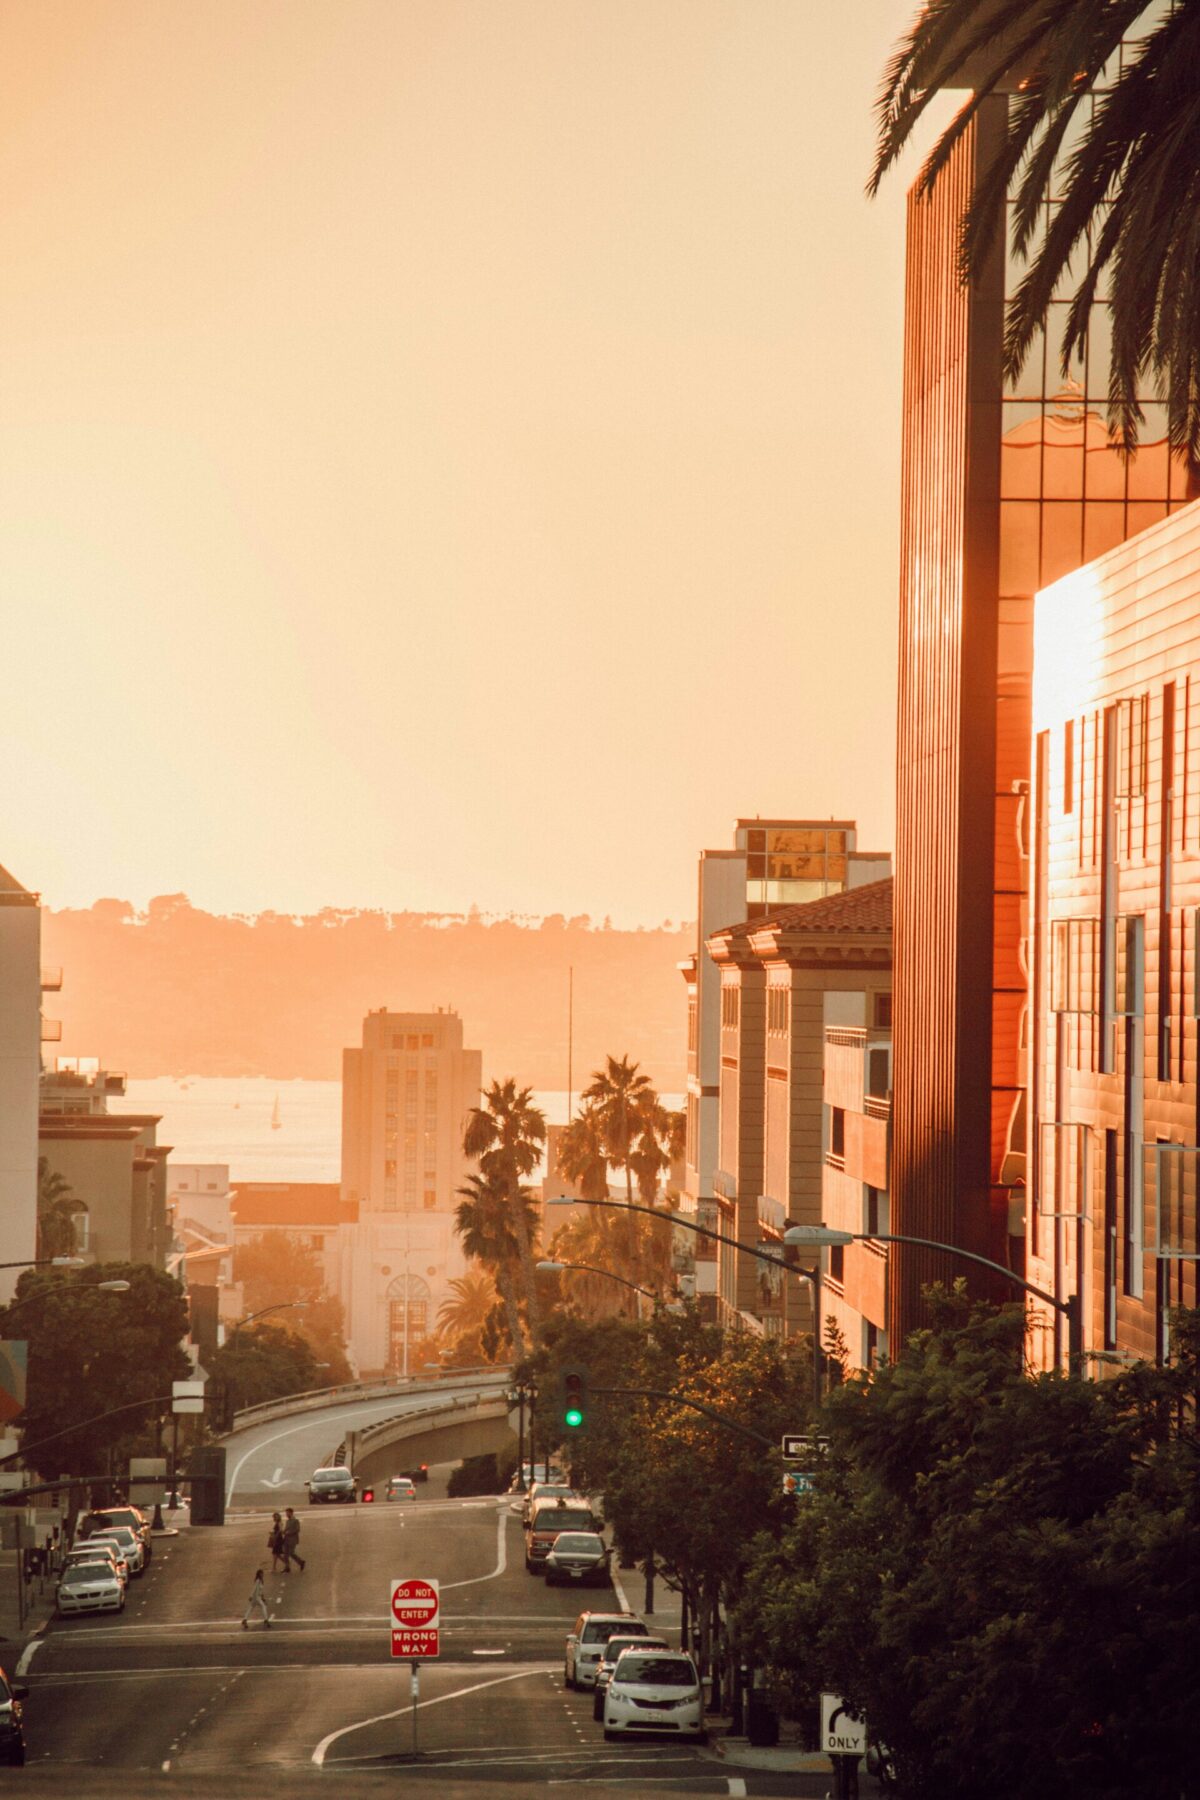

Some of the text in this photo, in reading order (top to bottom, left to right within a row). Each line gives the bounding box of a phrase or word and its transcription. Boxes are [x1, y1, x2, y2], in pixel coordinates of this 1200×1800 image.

[398, 1588, 432, 1597] DO NOT
[401, 1610, 429, 1619] ENTER
[393, 1632, 437, 1641] WRONG
[402, 1645, 428, 1653] WAY
[828, 1736, 860, 1749] ONLY
